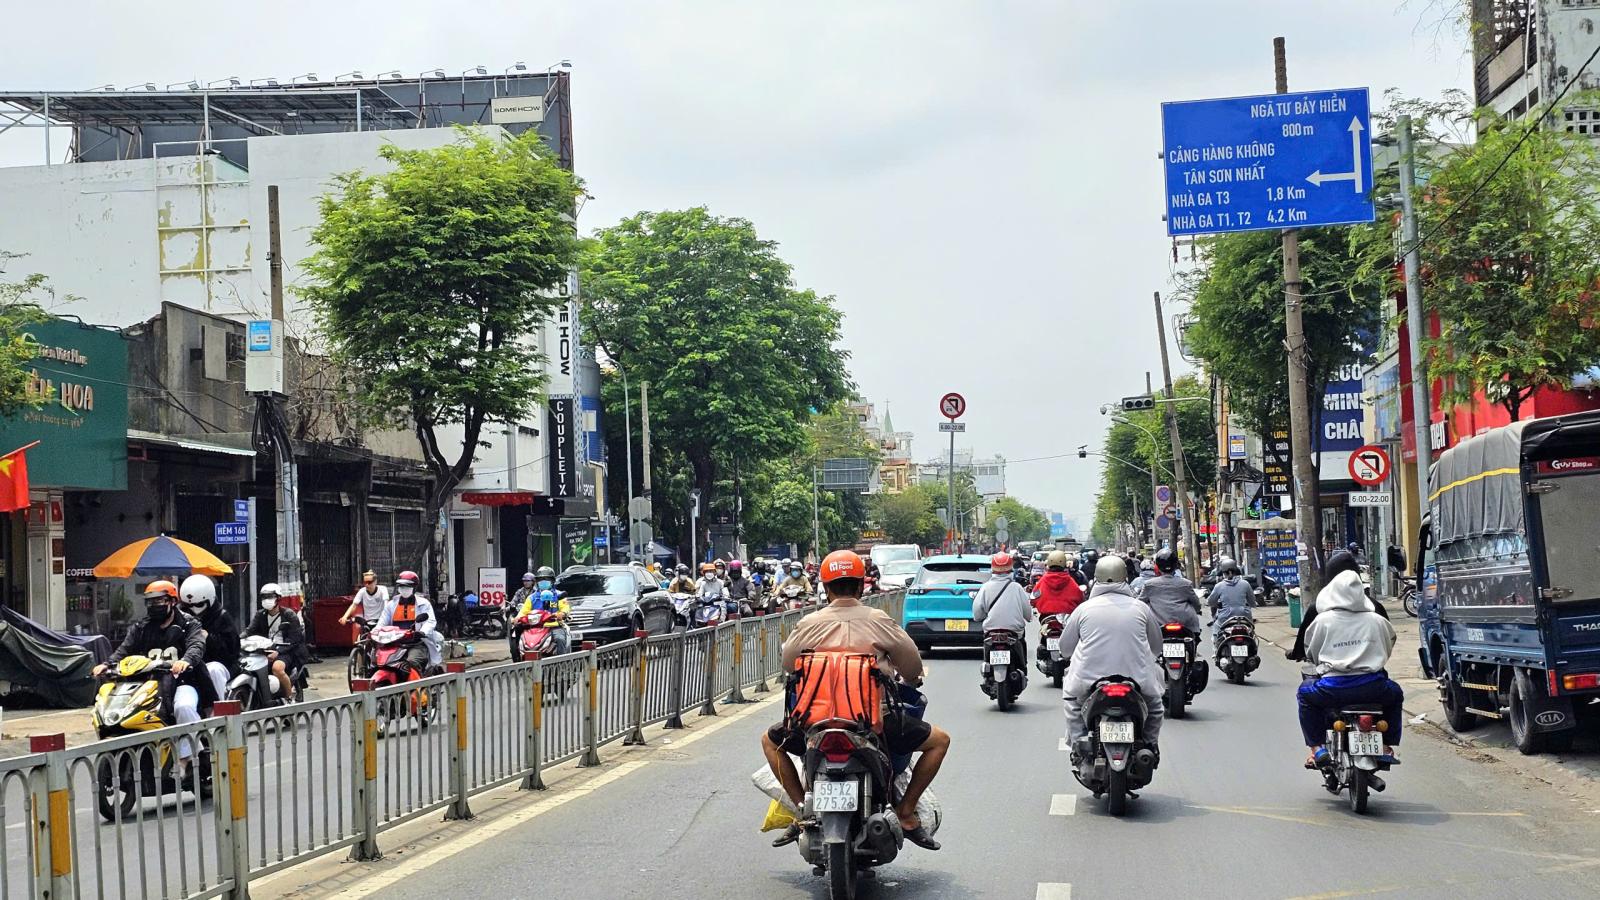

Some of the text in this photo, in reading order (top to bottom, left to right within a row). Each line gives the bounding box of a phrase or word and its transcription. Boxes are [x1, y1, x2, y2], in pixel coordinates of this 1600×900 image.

[1251, 101, 1275, 118] NGÃ
[1276, 102, 1292, 116] TƯ
[1295, 96, 1316, 115] BẢY
[1282, 123, 1314, 137] 800 m
[1170, 140, 1275, 163] CẢNG HÀNG KHÔNG
[1183, 160, 1266, 185] TÂN SƠN NHẤT
[1172, 186, 1306, 208] NHÀ GA T3 1,8 Km
[1173, 211, 1196, 230] NHÀ
[1199, 214, 1214, 228] GA
[1237, 211, 1251, 225] T2
[1267, 209, 1285, 224] 4,2
[1288, 208, 1307, 222] Km
[61, 382, 94, 411] HOA
[1270, 484, 1288, 492] 10K
[234, 527, 246, 535] 168
[66, 568, 94, 577] COFFEE
[1540, 713, 1560, 723] KIA
[820, 782, 852, 796] 59-X2
